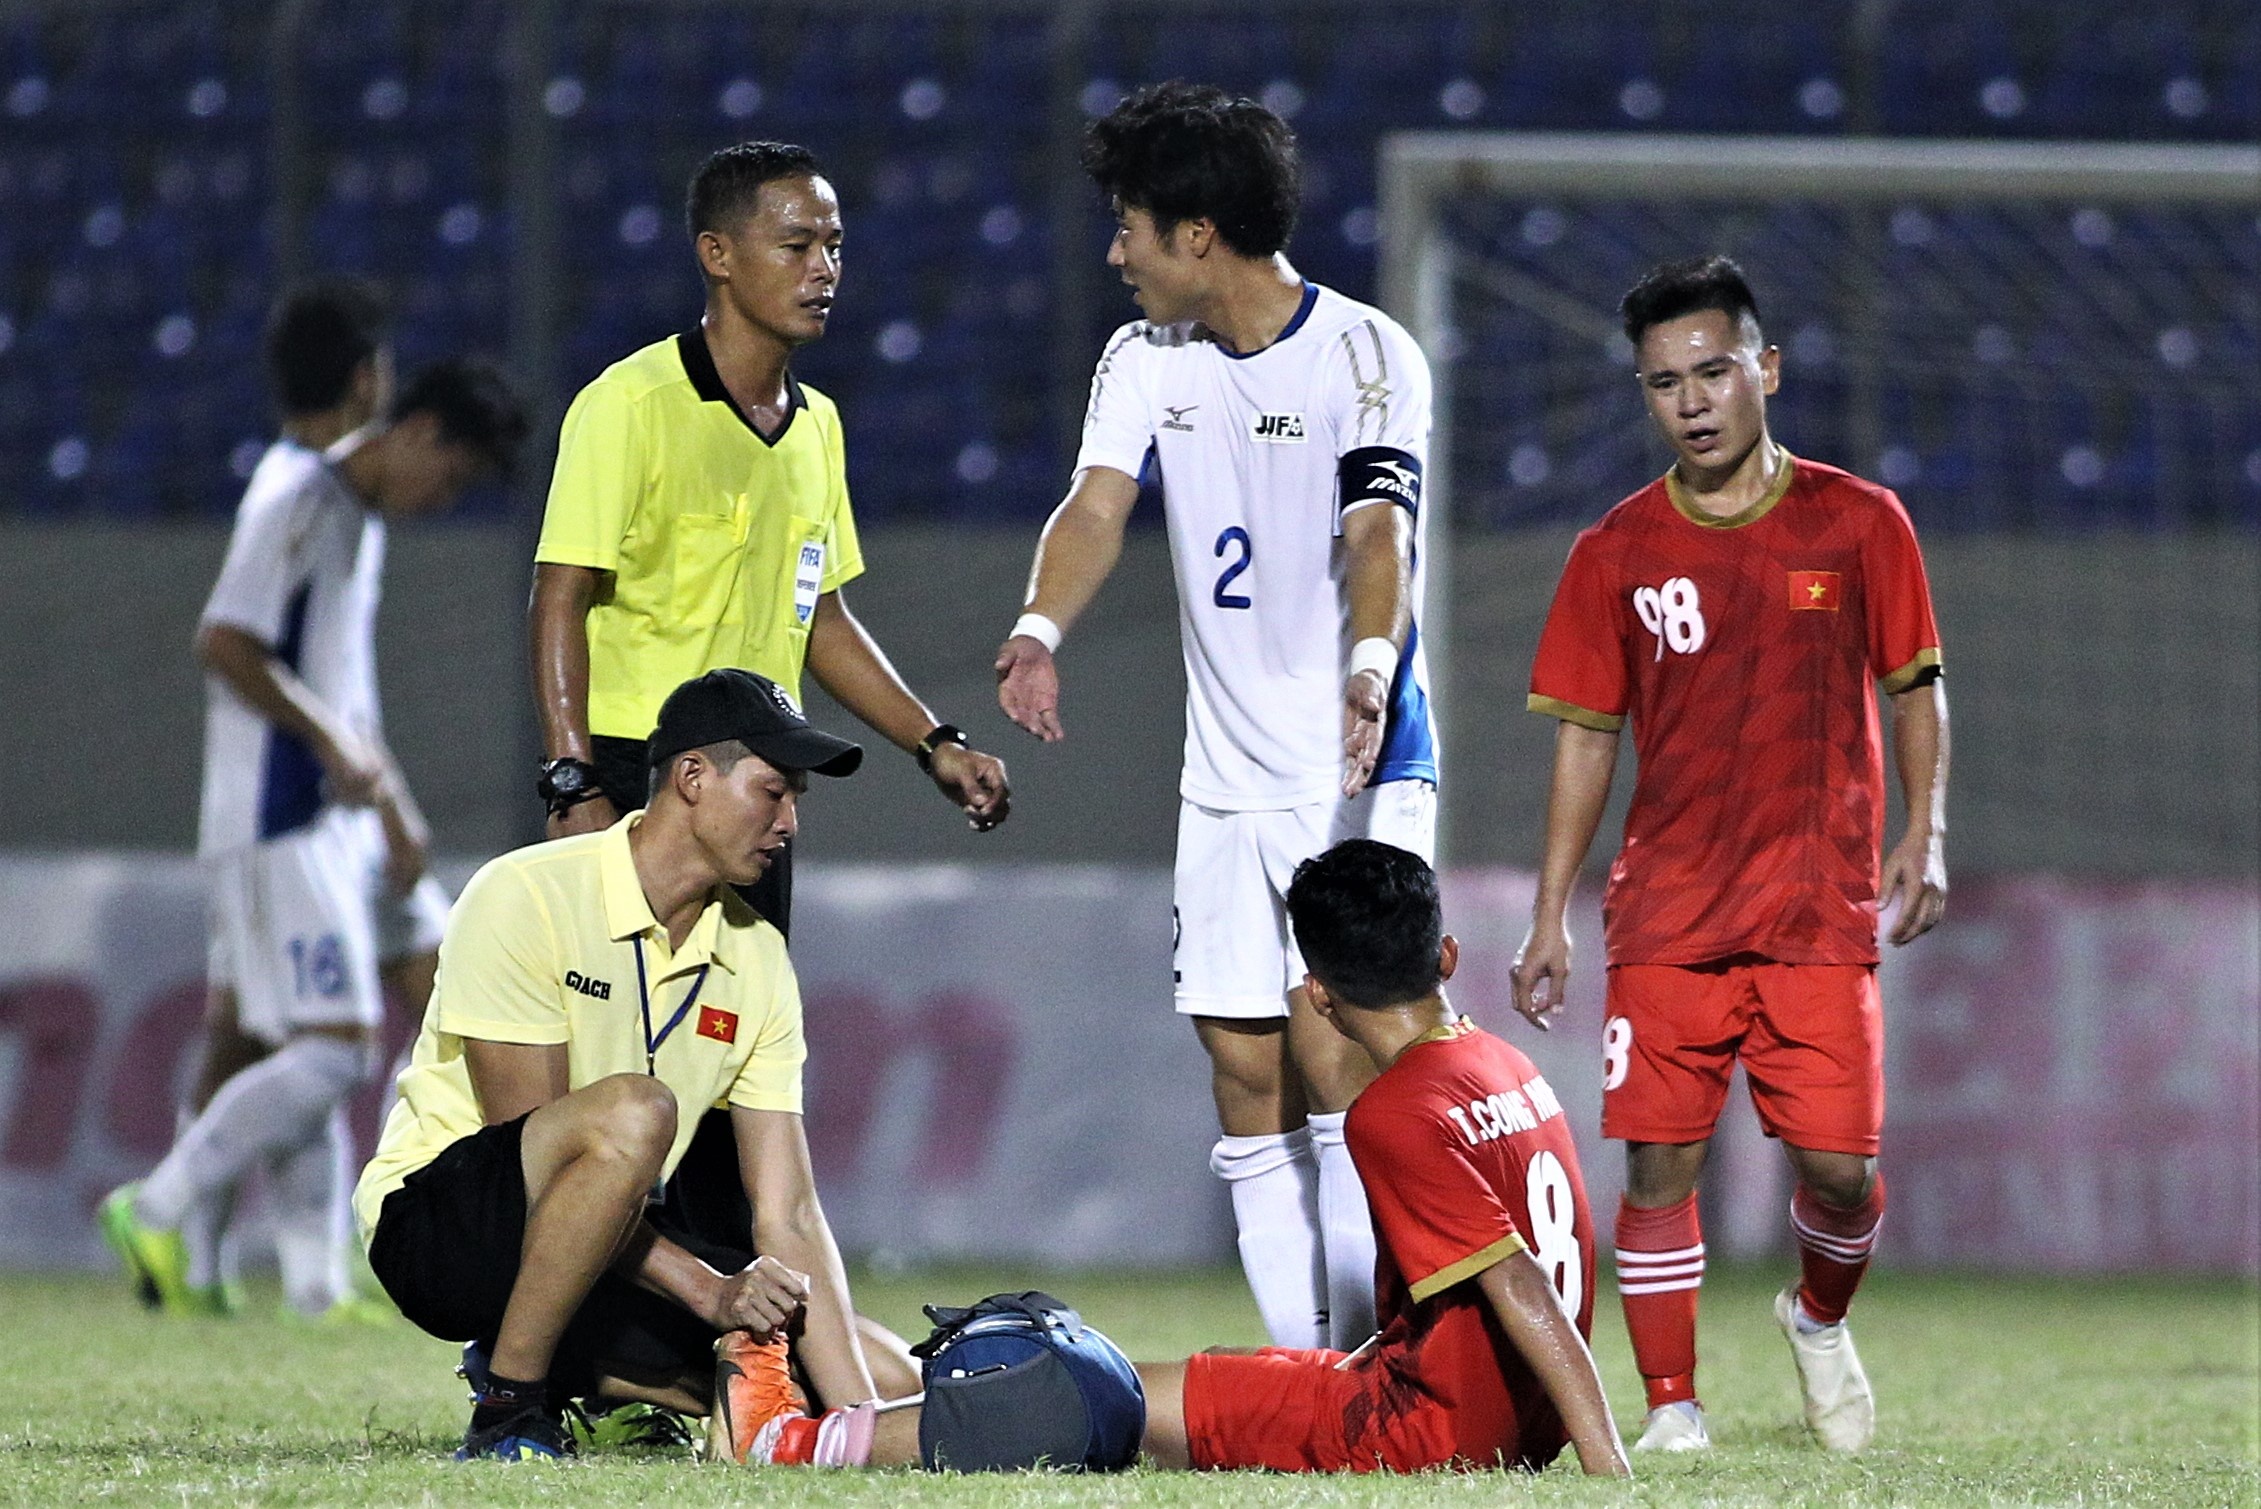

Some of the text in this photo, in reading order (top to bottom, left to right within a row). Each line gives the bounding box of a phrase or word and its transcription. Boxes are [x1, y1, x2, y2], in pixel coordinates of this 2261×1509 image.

[800, 546, 821, 568] FIFA
[1213, 526, 1251, 609] 2
[1633, 577, 1706, 662] 98
[1526, 1151, 1582, 1321] 8
